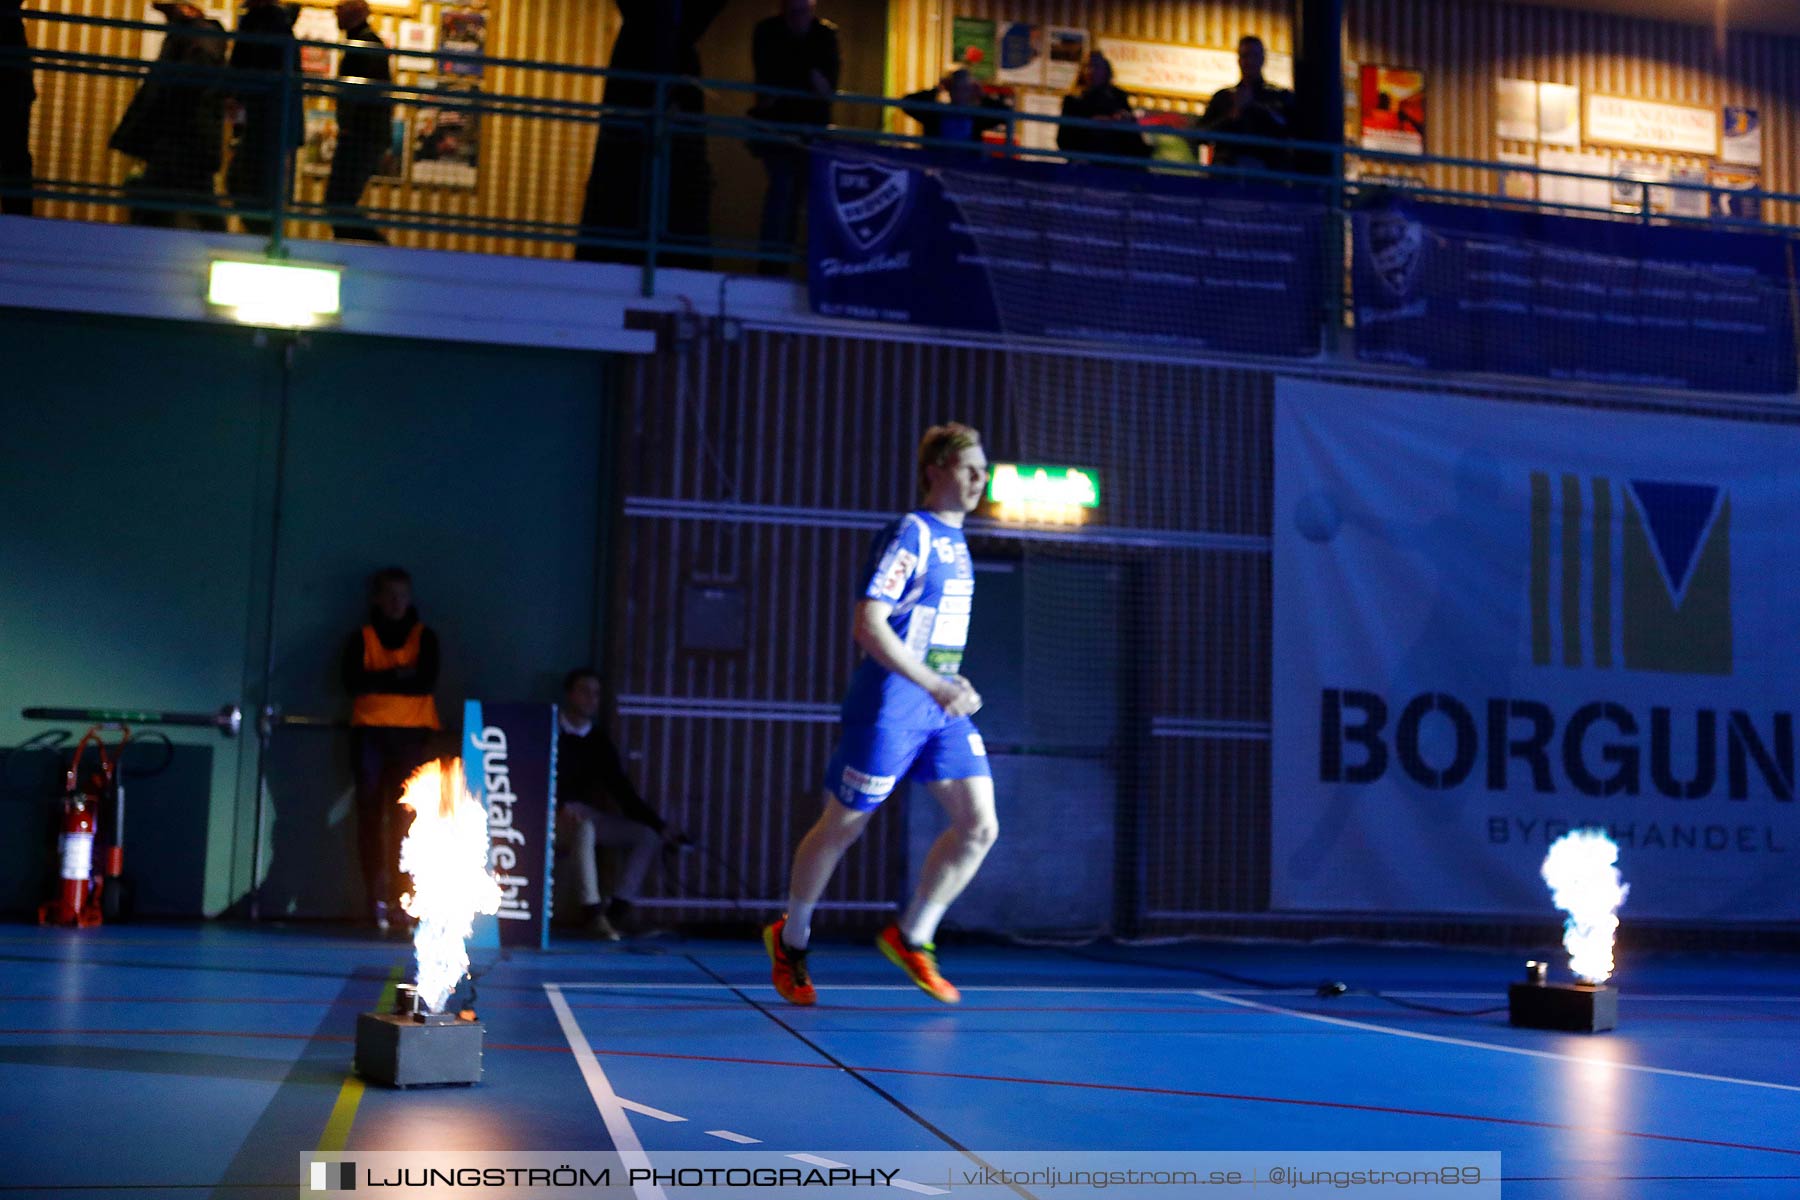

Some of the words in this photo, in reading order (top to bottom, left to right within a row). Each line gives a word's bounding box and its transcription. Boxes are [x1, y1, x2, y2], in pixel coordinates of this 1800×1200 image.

[471, 726, 526, 846] gustaf
[1319, 687, 1796, 802] BORGUN
[1486, 816, 1785, 853] BYHANDEL
